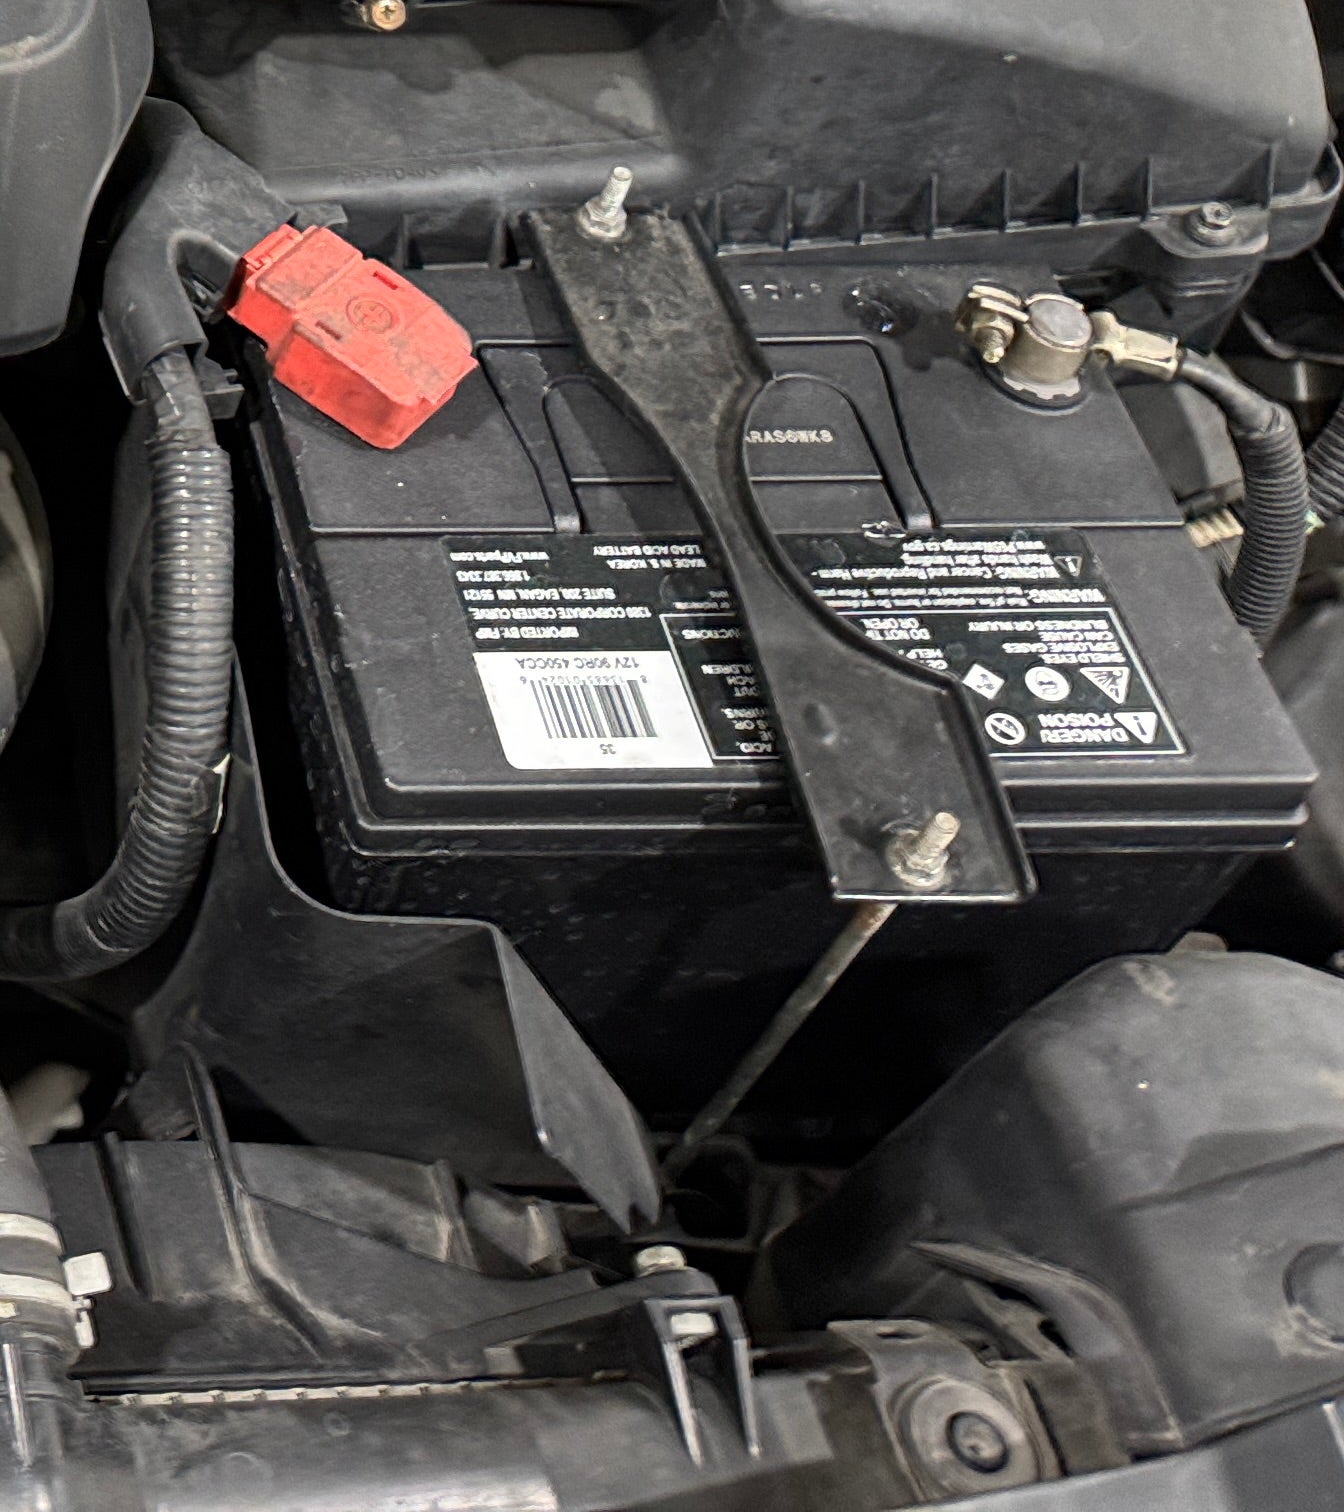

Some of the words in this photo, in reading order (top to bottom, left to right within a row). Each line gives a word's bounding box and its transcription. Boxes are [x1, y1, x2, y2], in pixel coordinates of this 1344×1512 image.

[592, 545, 642, 557] BATTERY
[641, 545, 670, 556] ACID
[670, 544, 702, 556] LEAD
[606, 558, 647, 569] KOREA
[660, 557, 674, 569] IN
[674, 557, 707, 569] MADE
[818, 568, 851, 580] Harm
[850, 565, 928, 580] Reproductive
[926, 567, 951, 579] and
[950, 566, 992, 578] Cancer
[992, 565, 1061, 579] WARNING:
[462, 588, 495, 600] 55121
[582, 587, 617, 599] SUITE
[1023, 588, 1106, 603] WARNING:
[510, 607, 557, 619] CENTER
[556, 606, 626, 619] CORPORATE
[898, 617, 920, 629] OR
[967, 621, 1013, 632] INJURY
[1013, 620, 1035, 631] OR
[1034, 619, 1109, 630] BLINDNESS
[520, 626, 580, 639] IMPORTED
[884, 629, 910, 640] NOT
[909, 628, 932, 640] DO
[1038, 631, 1084, 641] CAUSE
[1083, 631, 1114, 641] CAN
[1002, 642, 1048, 653] GASES
[1047, 641, 1121, 652] EXPLOSIVE
[514, 657, 570, 670] 450CCA
[614, 657, 640, 669] 12V
[1078, 652, 1126, 663] SHIELD
[1038, 712, 1116, 727] POISON
[1039, 728, 1130, 743] DANGER!
[599, 743, 615, 755] 35
